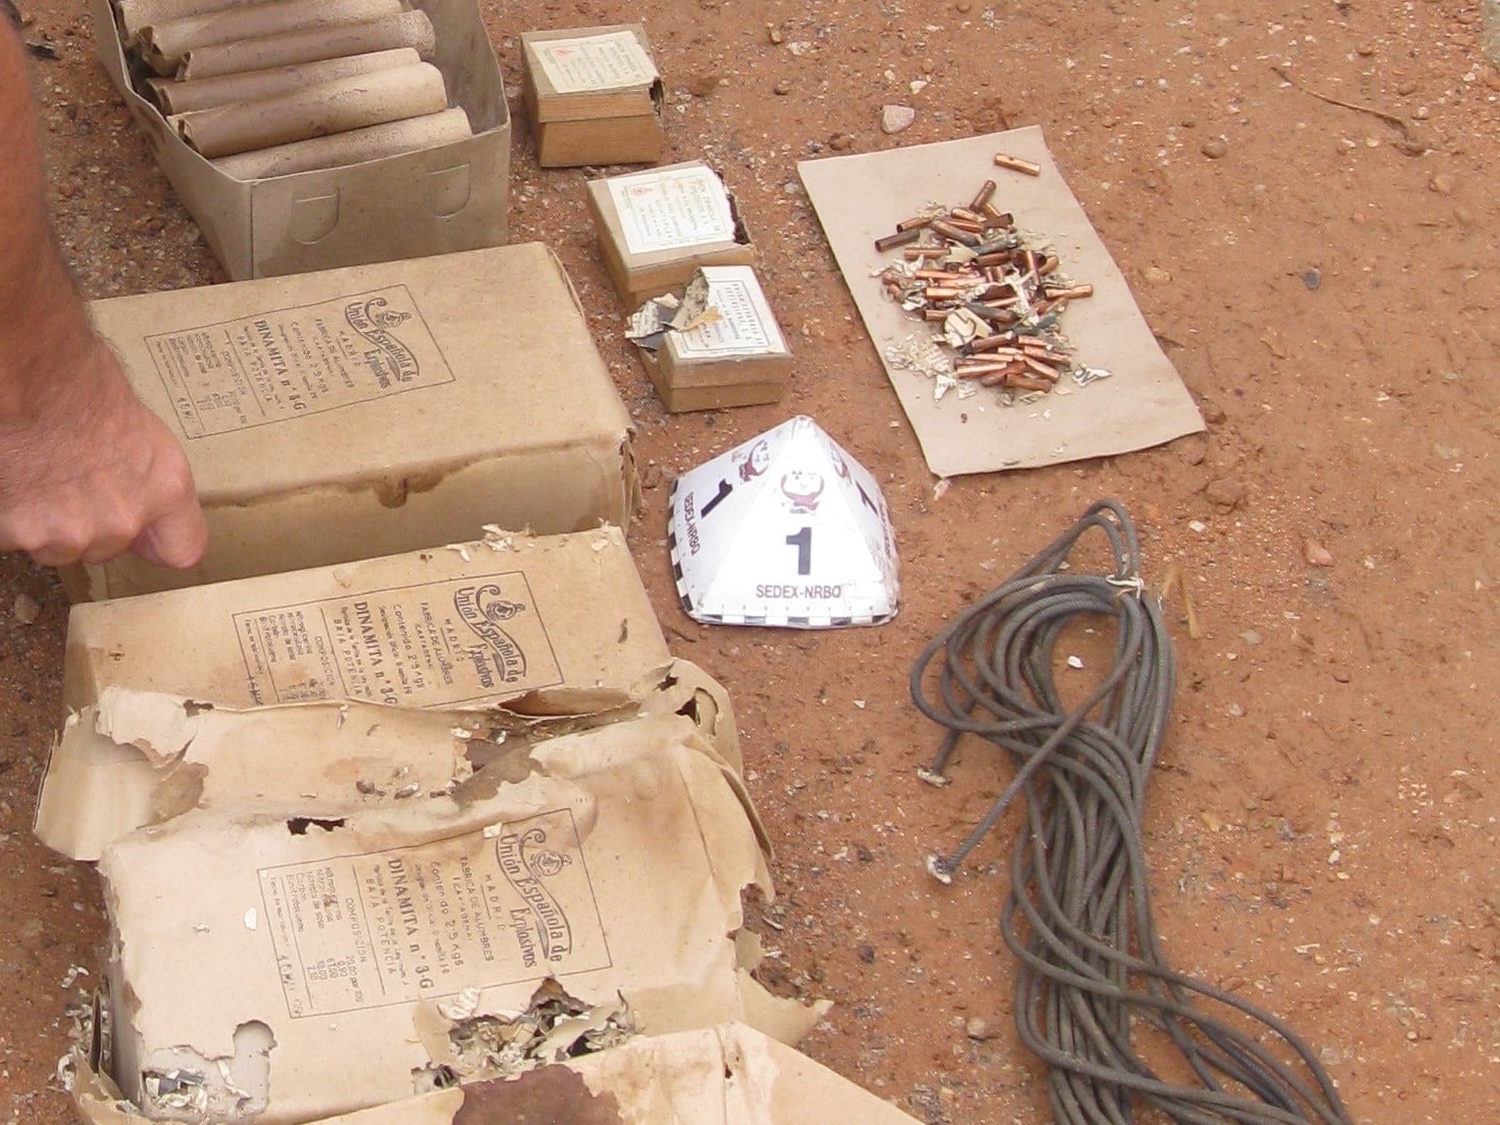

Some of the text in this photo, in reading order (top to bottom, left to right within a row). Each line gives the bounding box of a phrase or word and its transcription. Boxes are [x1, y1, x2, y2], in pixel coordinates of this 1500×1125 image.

[254, 320, 288, 375] DINAMITA
[700, 478, 733, 519] 1
[786, 527, 812, 575] 1
[756, 584, 842, 599] SEDEX-NRBQ
[354, 602, 382, 666] DINAMITA
[456, 587, 525, 683] Unión Española de
[388, 858, 418, 935] DINAMITA
[430, 861, 449, 914] Contendo
[498, 834, 570, 961] Unión Española de
[510, 907, 537, 968] Explosivos
